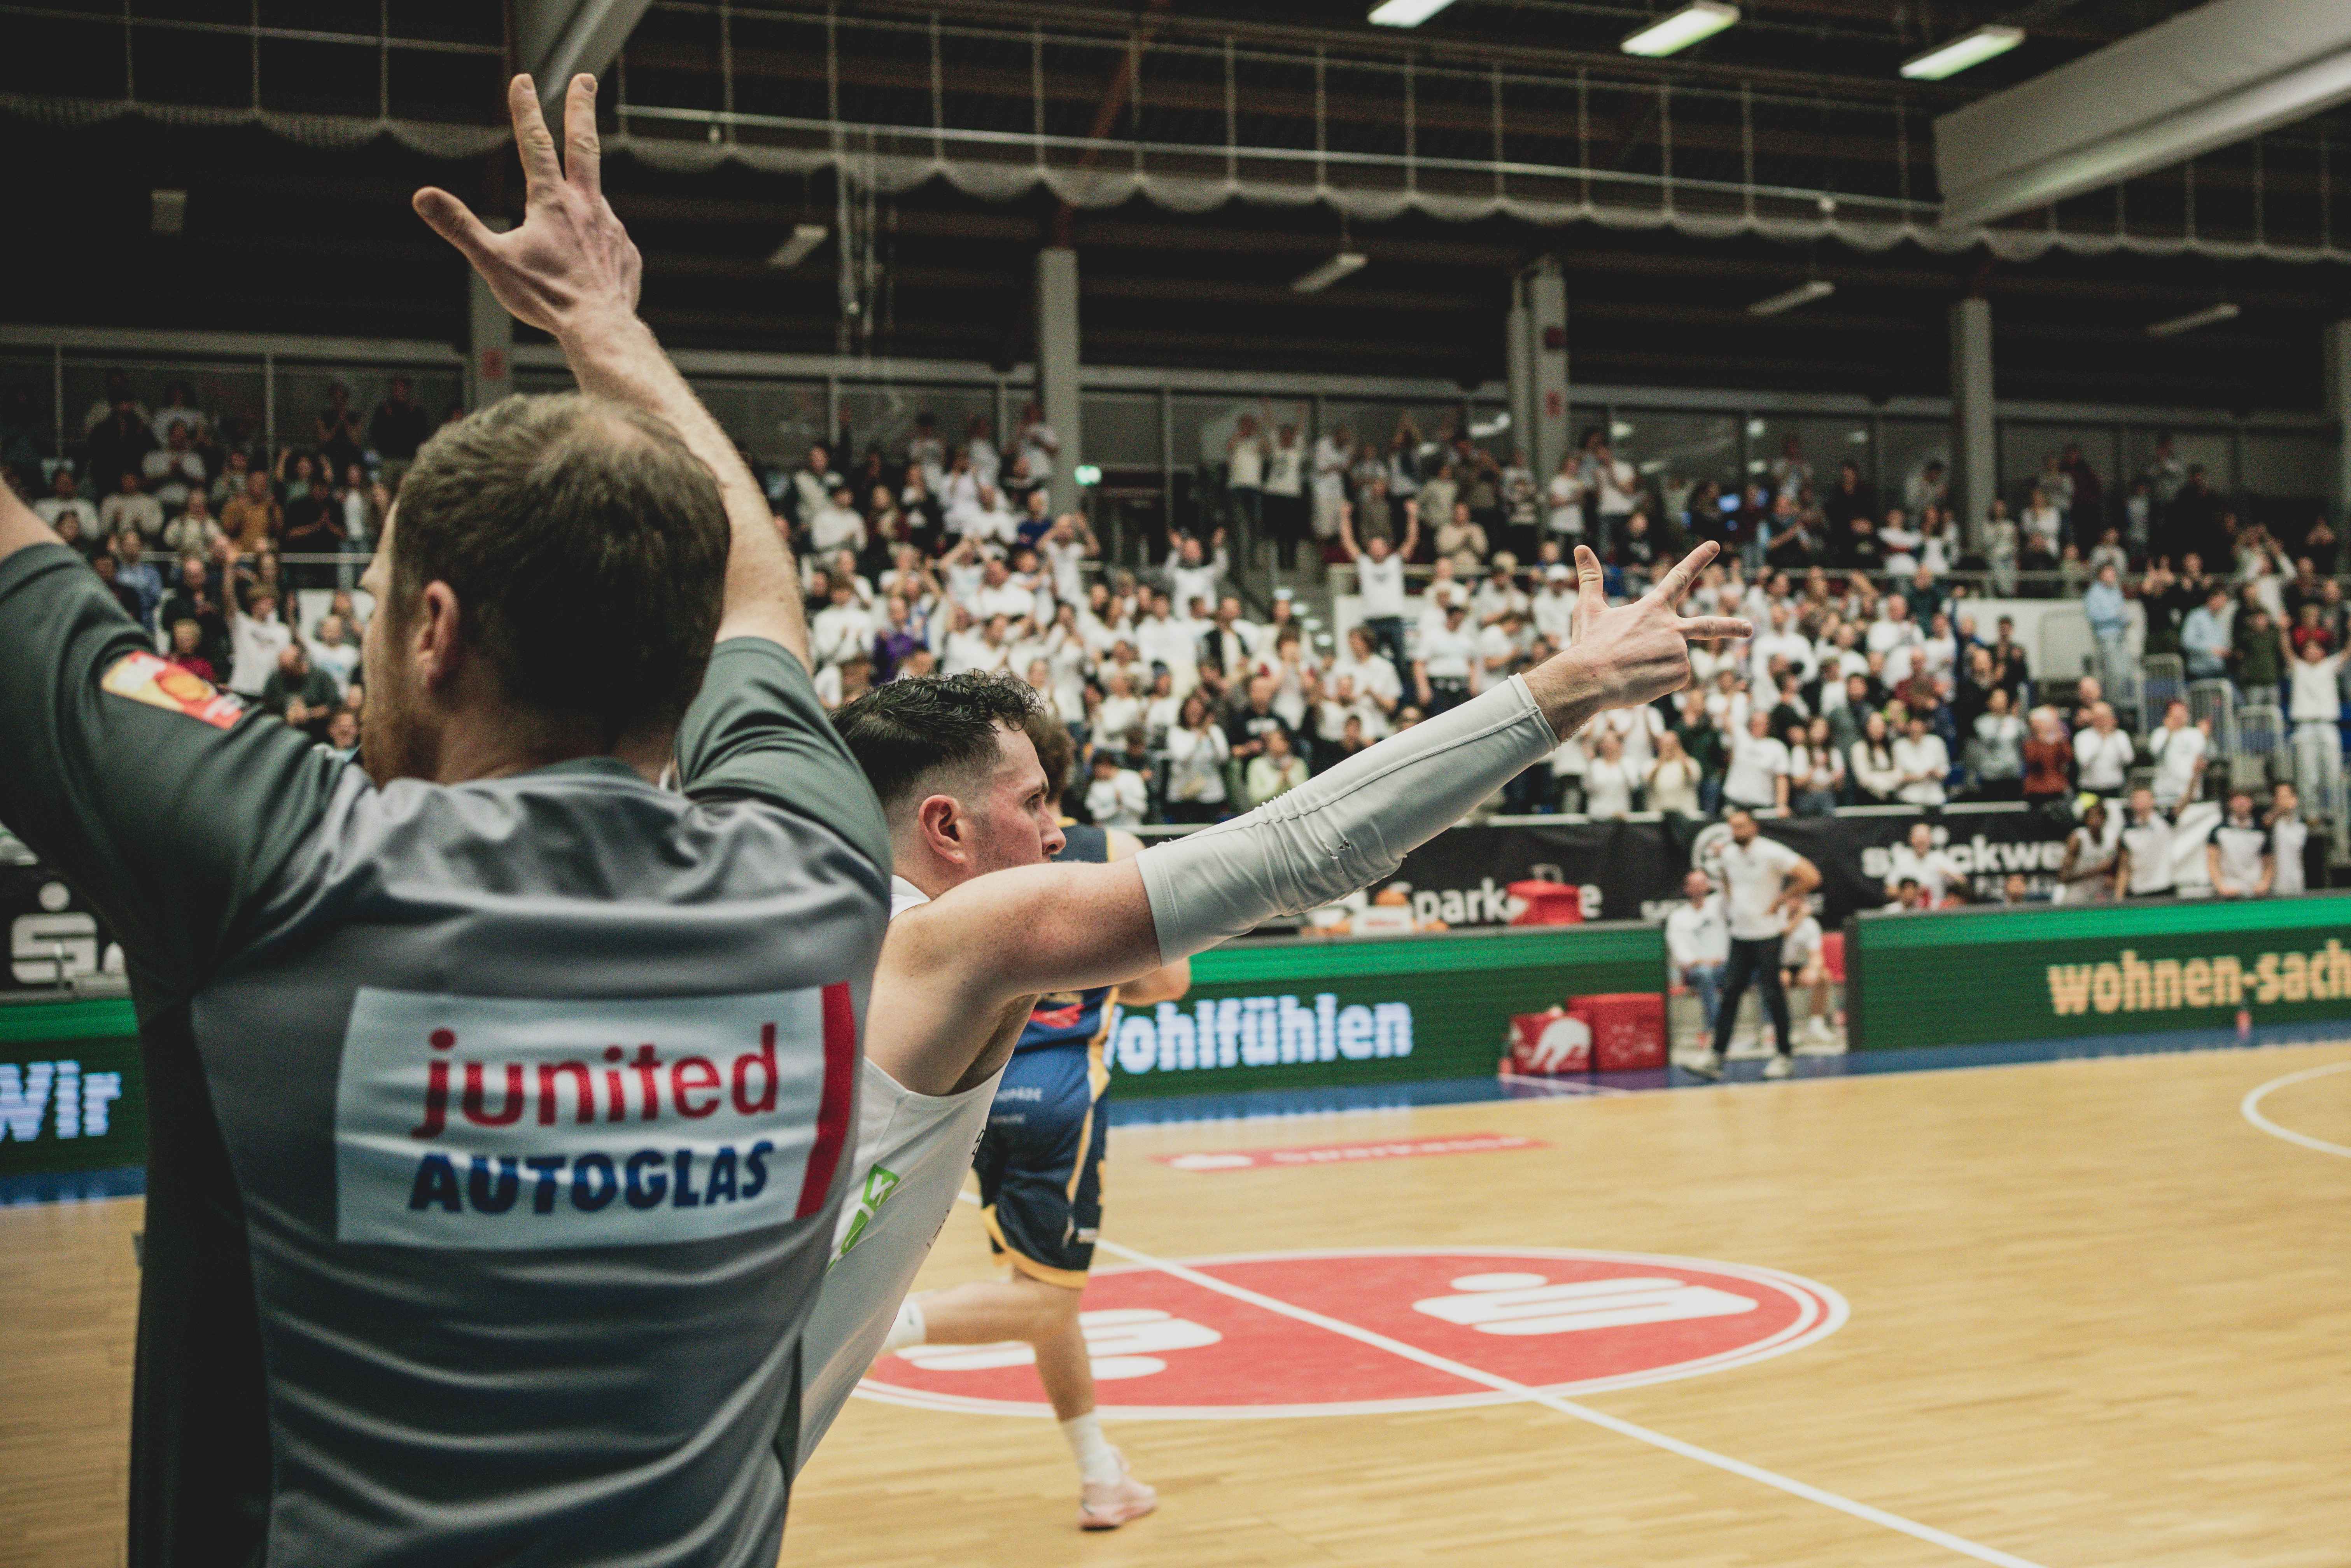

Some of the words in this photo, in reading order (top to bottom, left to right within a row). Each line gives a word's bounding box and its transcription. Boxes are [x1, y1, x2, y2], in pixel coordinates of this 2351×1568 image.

[2047, 938, 2351, 1017] wohnen-sach
[411, 1022, 778, 1141] junited
[408, 1140, 775, 1215] AUTOGLAS
